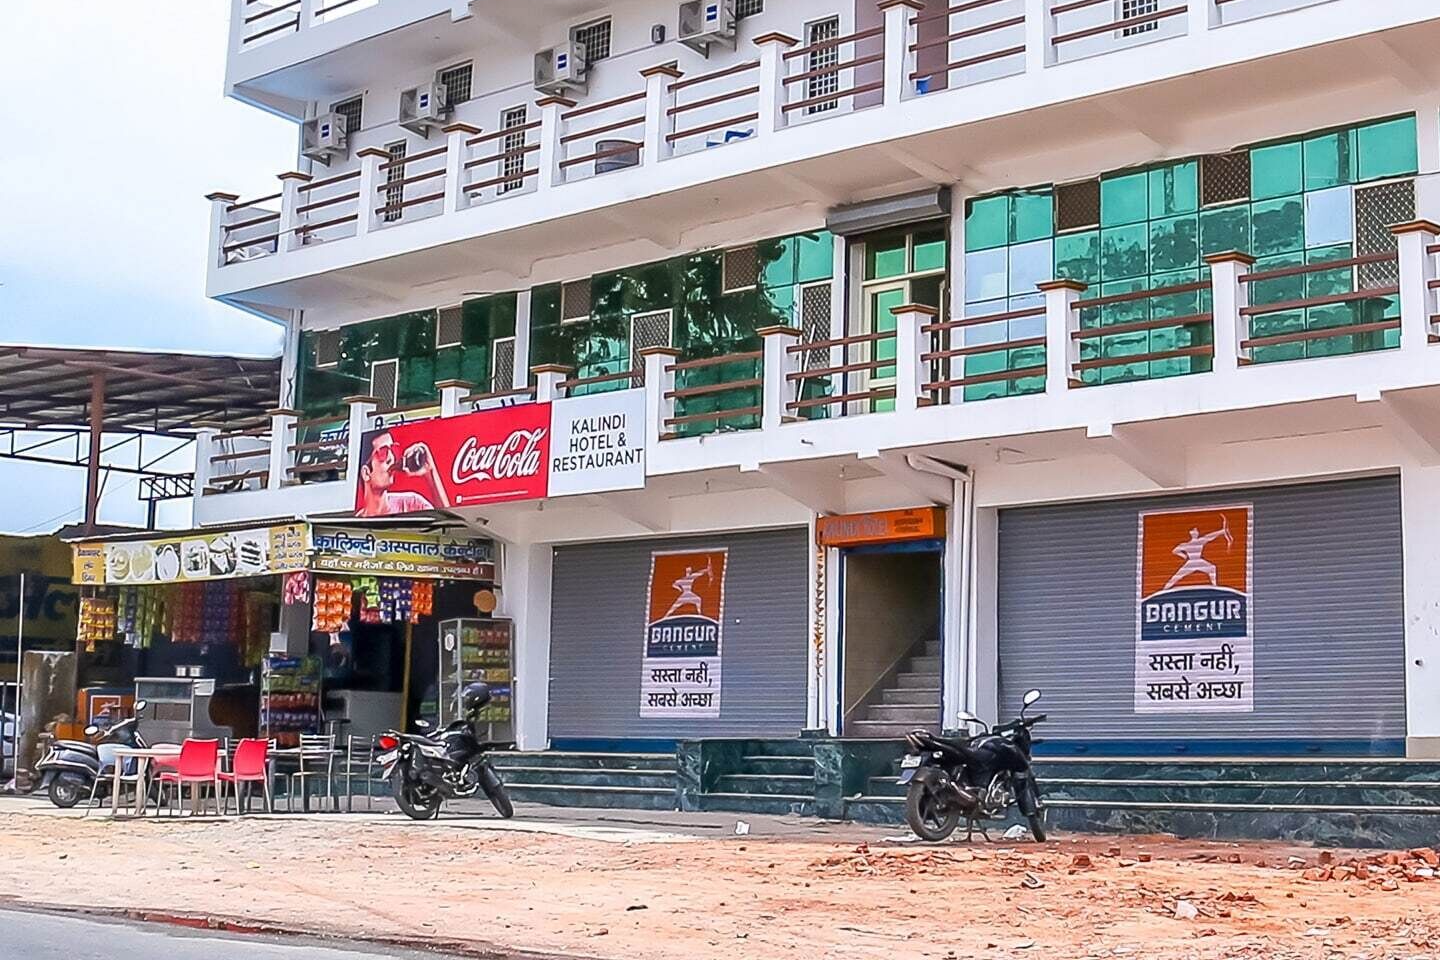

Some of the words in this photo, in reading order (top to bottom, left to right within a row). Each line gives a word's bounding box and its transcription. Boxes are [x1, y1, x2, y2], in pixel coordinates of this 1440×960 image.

[571, 414, 626, 434] KALINDI
[569, 435, 609, 452] HOTEL
[610, 432, 627, 447] &
[451, 427, 548, 484] Coca-Cola
[552, 449, 644, 472] RESTAURANT
[379, 539, 439, 556] अस्पताल
[1146, 599, 1242, 623] BANGUR
[651, 625, 716, 644] BANGUR
[1163, 623, 1223, 633] CEMENT
[1149, 652, 1195, 671] सस्ता
[1200, 643, 1240, 674] नहीं,
[651, 667, 682, 683] सस्ता
[685, 662, 713, 687] नहीं,
[648, 687, 677, 708] सबसे
[680, 692, 715, 707] अच्छा
[1147, 676, 1192, 700] सबसे
[1197, 680, 1244, 699] अच्छा
